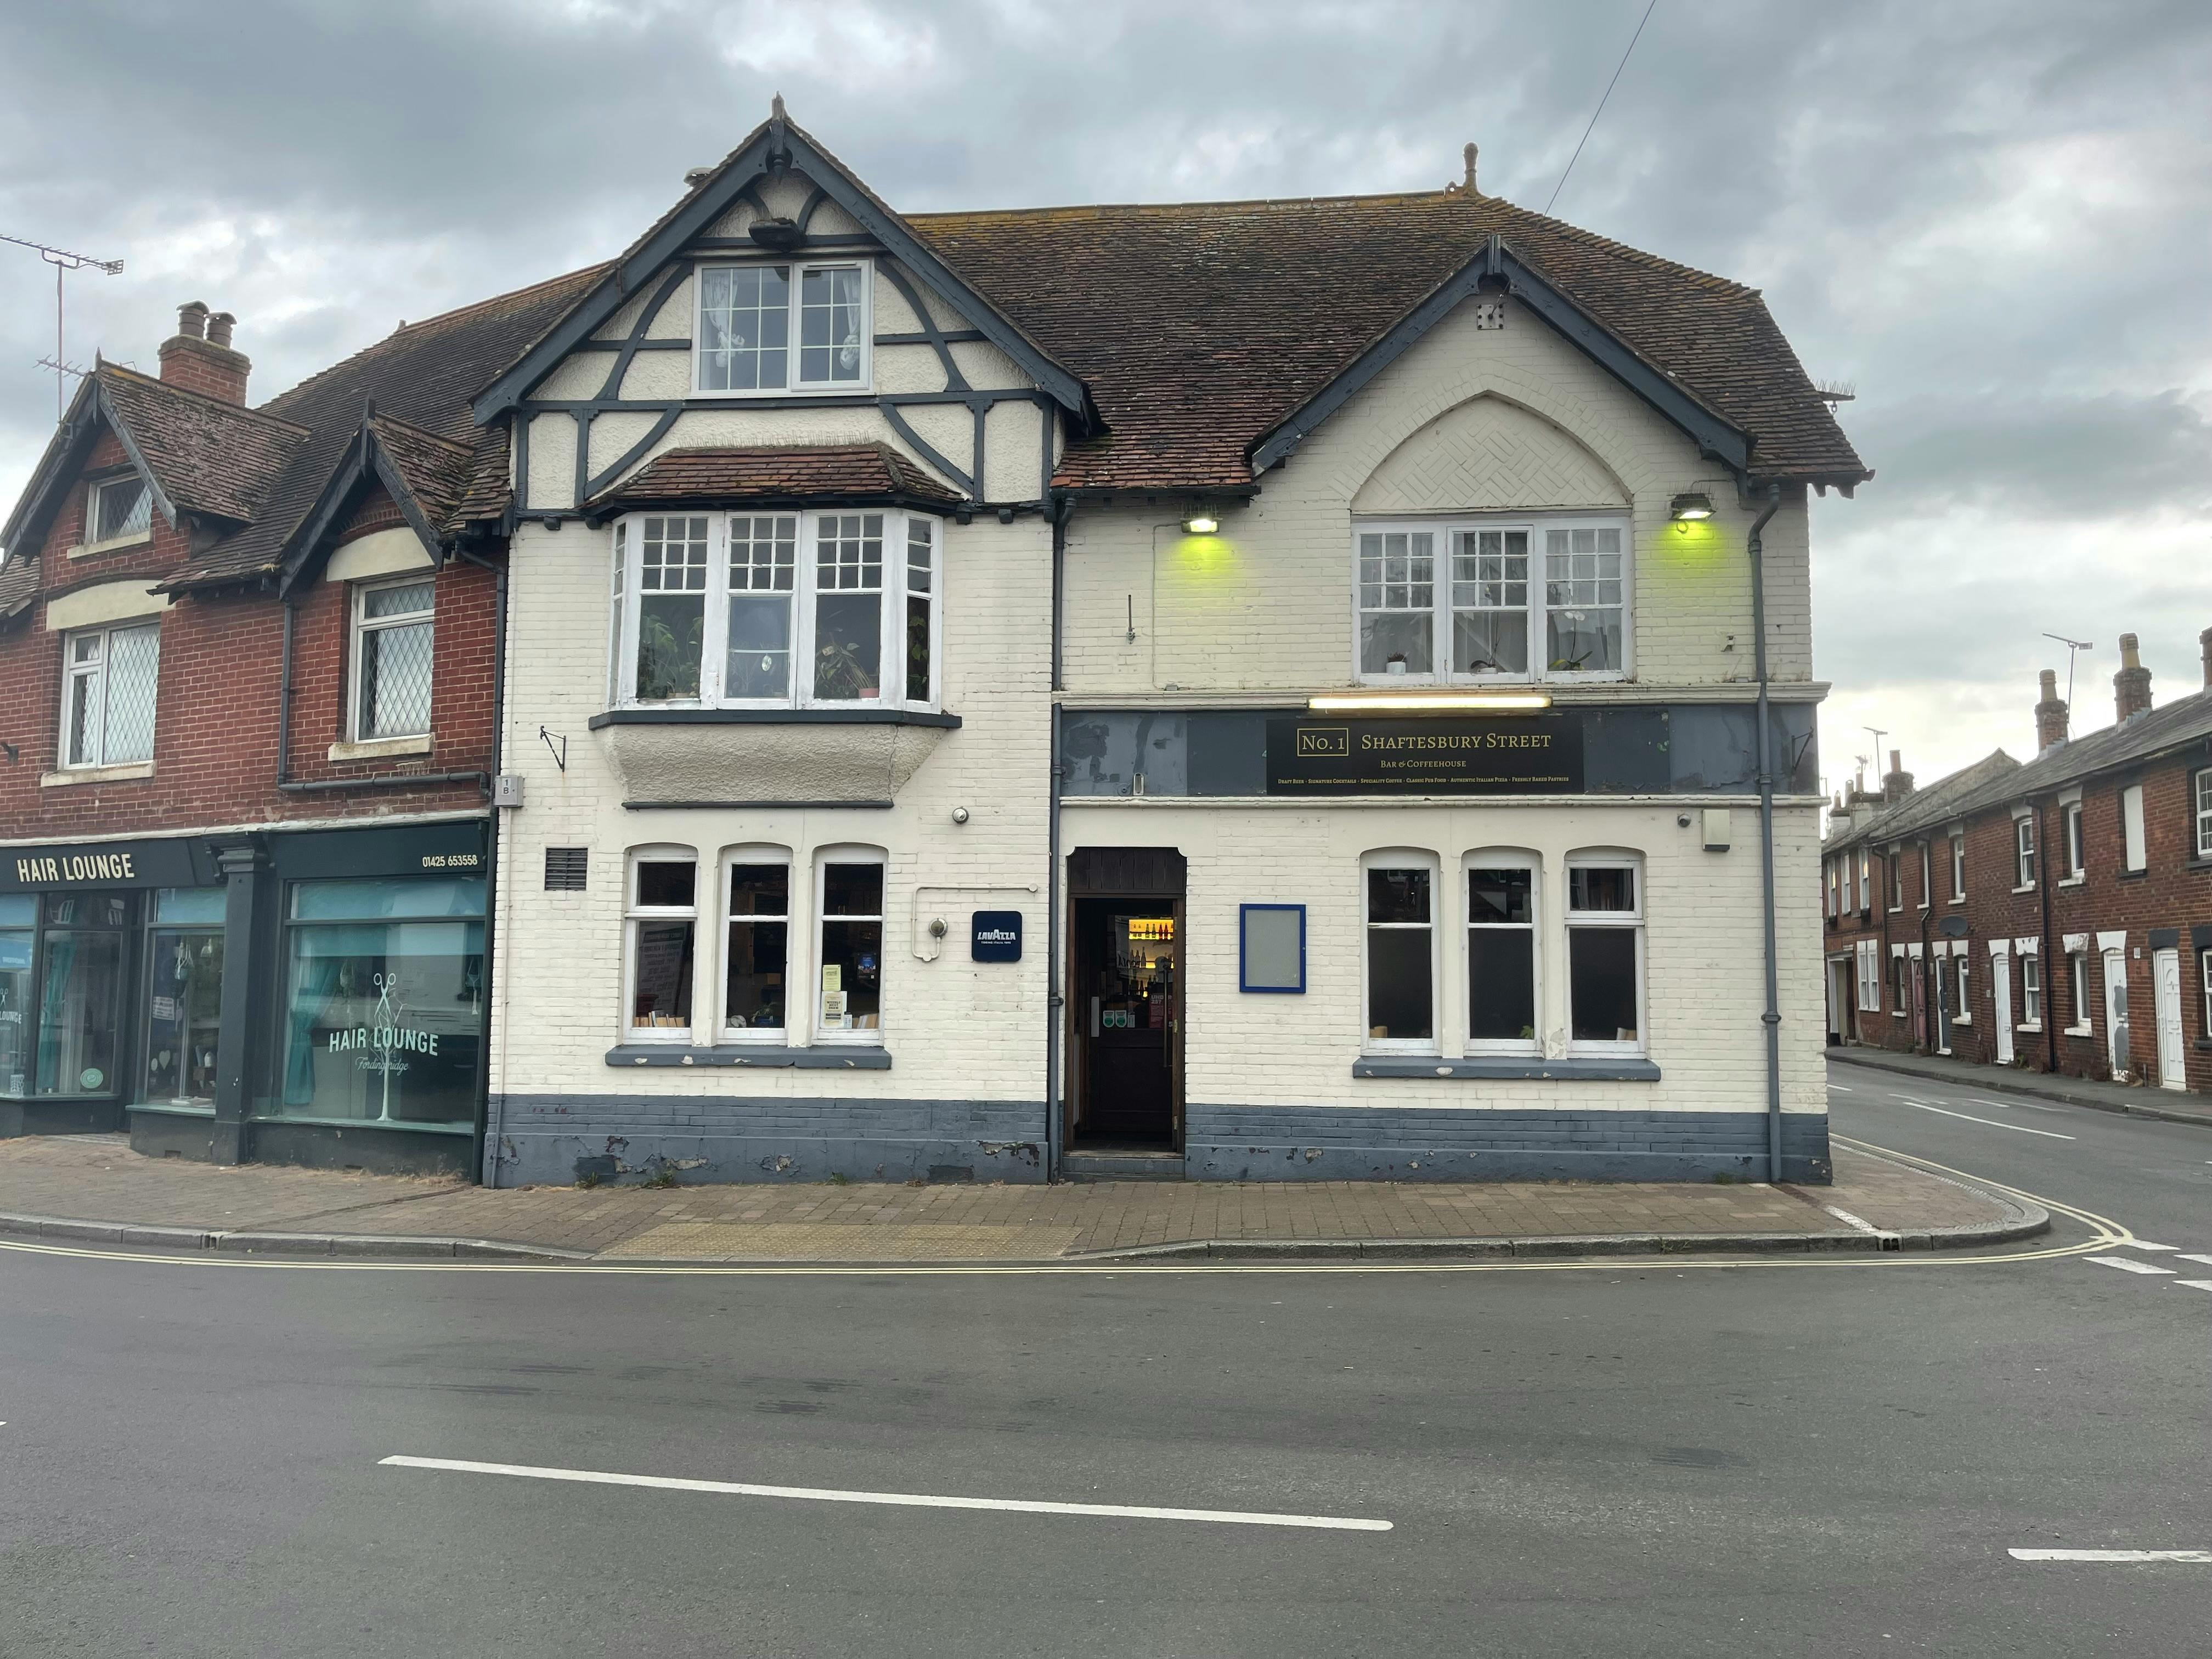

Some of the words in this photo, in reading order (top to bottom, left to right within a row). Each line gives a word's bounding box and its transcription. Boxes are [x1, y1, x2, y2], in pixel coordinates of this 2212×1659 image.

[1338, 737, 1345, 750] 1
[1361, 734, 1482, 749] SHAFTESBURY
[1486, 733, 1551, 748] STREET
[1380, 760, 1397, 768] BAR
[1407, 760, 1466, 768] COFFEEHOUSE
[17, 857, 59, 882] HAIR
[63, 854, 135, 881] LOUNGE
[422, 856, 445, 867] 01425
[448, 855, 478, 866] 653558
[977, 929, 1016, 940] LAVAZZA
[0, 1011, 21, 1024] LOUNGE
[329, 1028, 366, 1053] HAIR
[374, 1027, 439, 1057] LOUNGE
[355, 1057, 410, 1076] Fordingridge
